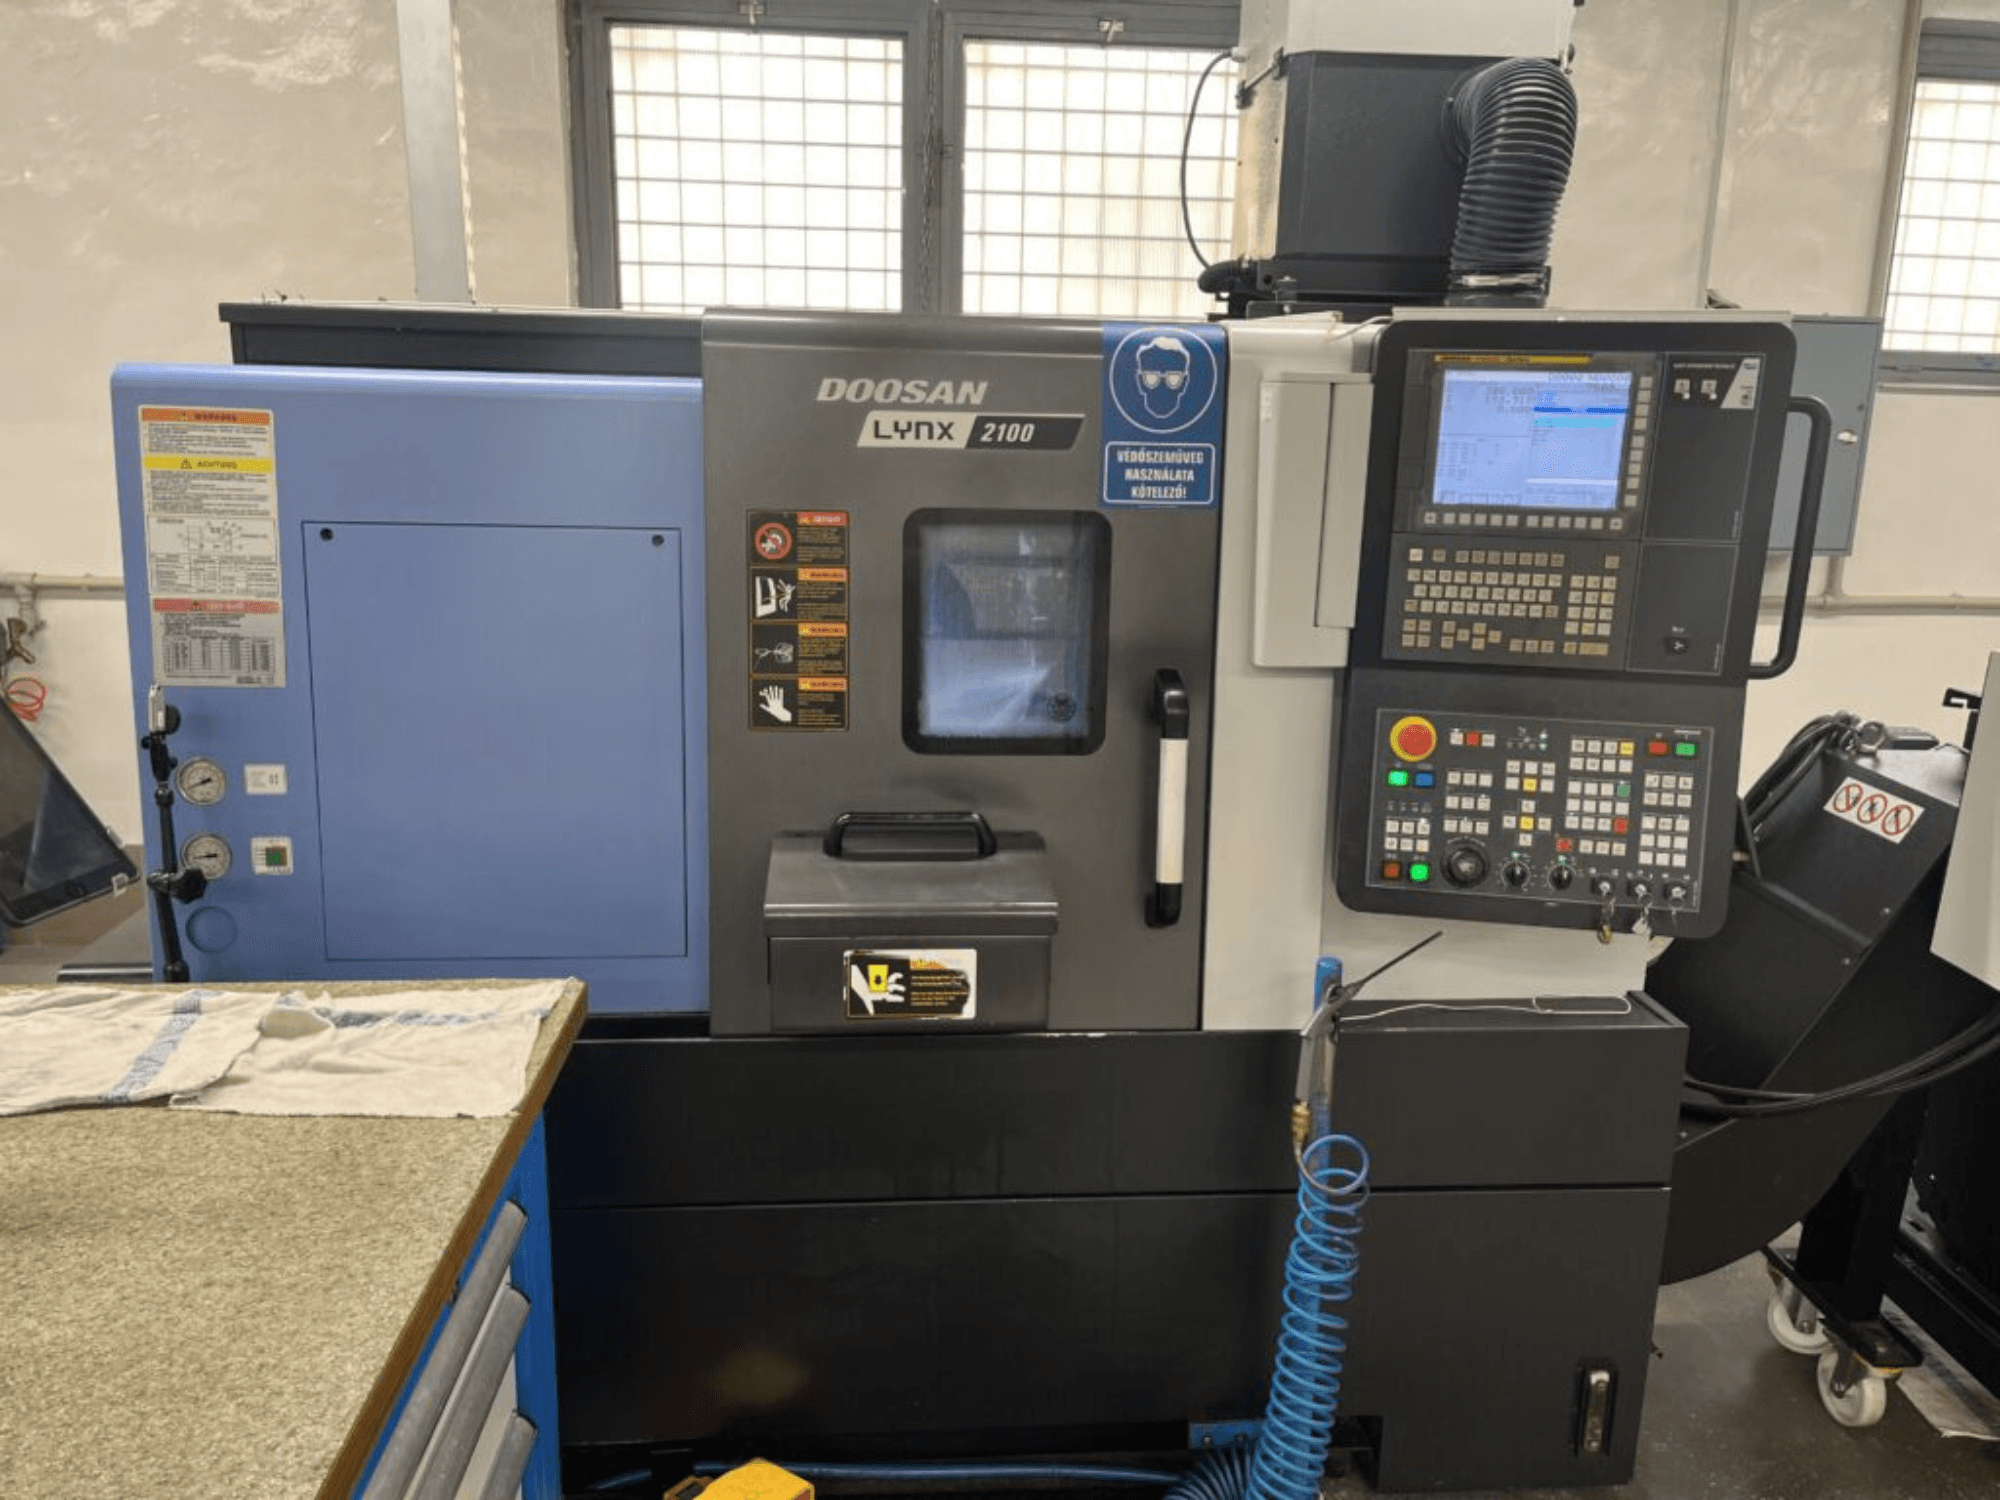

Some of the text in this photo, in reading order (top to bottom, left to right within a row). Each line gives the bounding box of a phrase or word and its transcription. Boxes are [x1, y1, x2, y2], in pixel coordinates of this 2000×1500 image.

[816, 377, 988, 405] DOOSAN
[873, 420, 1035, 443] LYNX 2100
[1124, 466, 1194, 481] HASZNÁLATA
[1130, 483, 1187, 499] KÖTELEZŐ!
